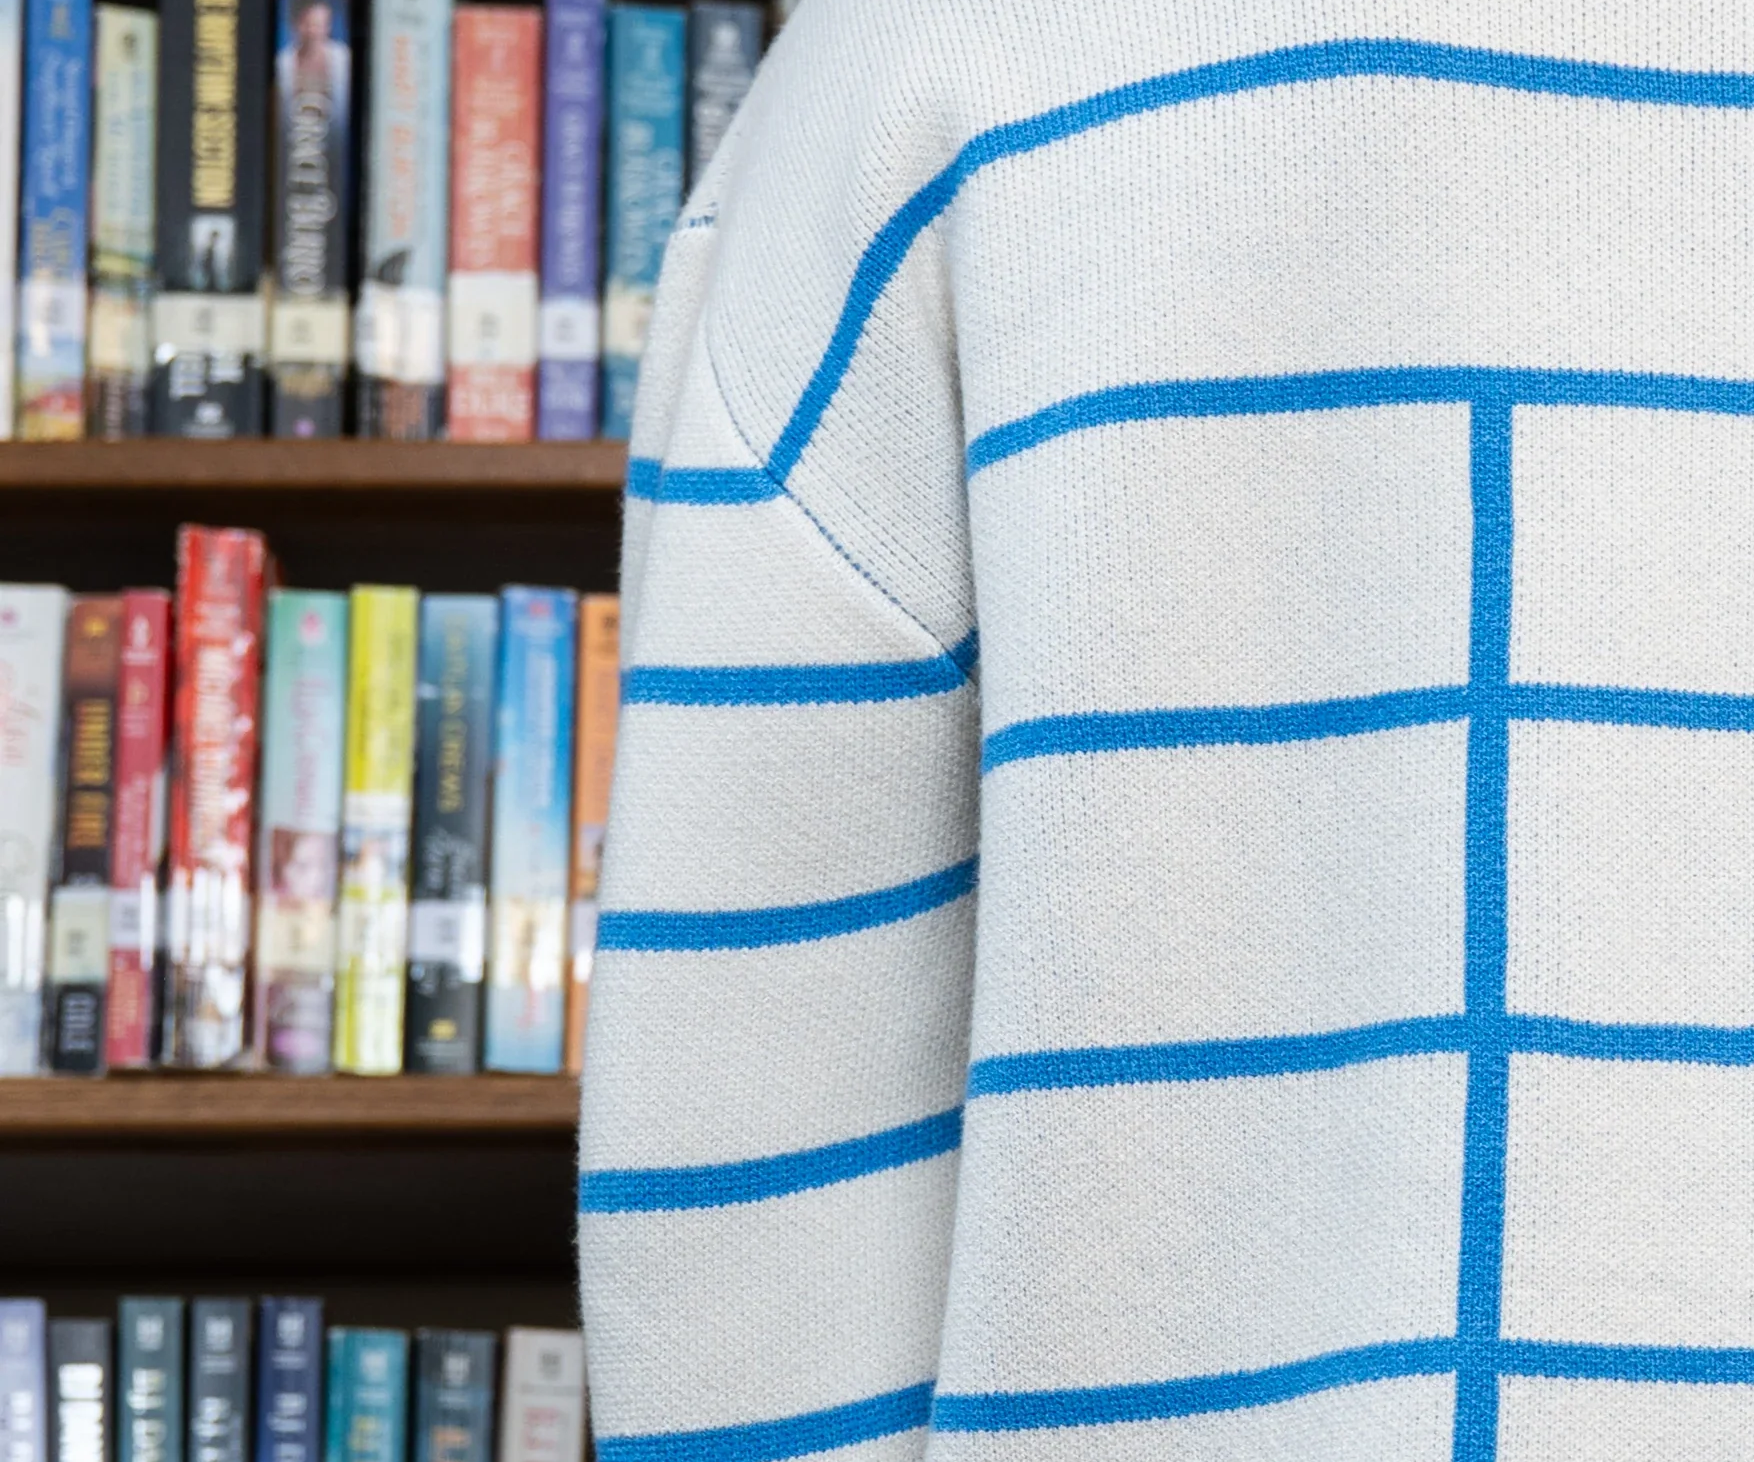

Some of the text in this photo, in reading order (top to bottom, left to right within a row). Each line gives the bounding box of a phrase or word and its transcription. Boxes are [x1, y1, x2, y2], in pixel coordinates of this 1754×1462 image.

[190, 105, 238, 207] SECTION
[287, 93, 338, 296] GRACE BURRO
